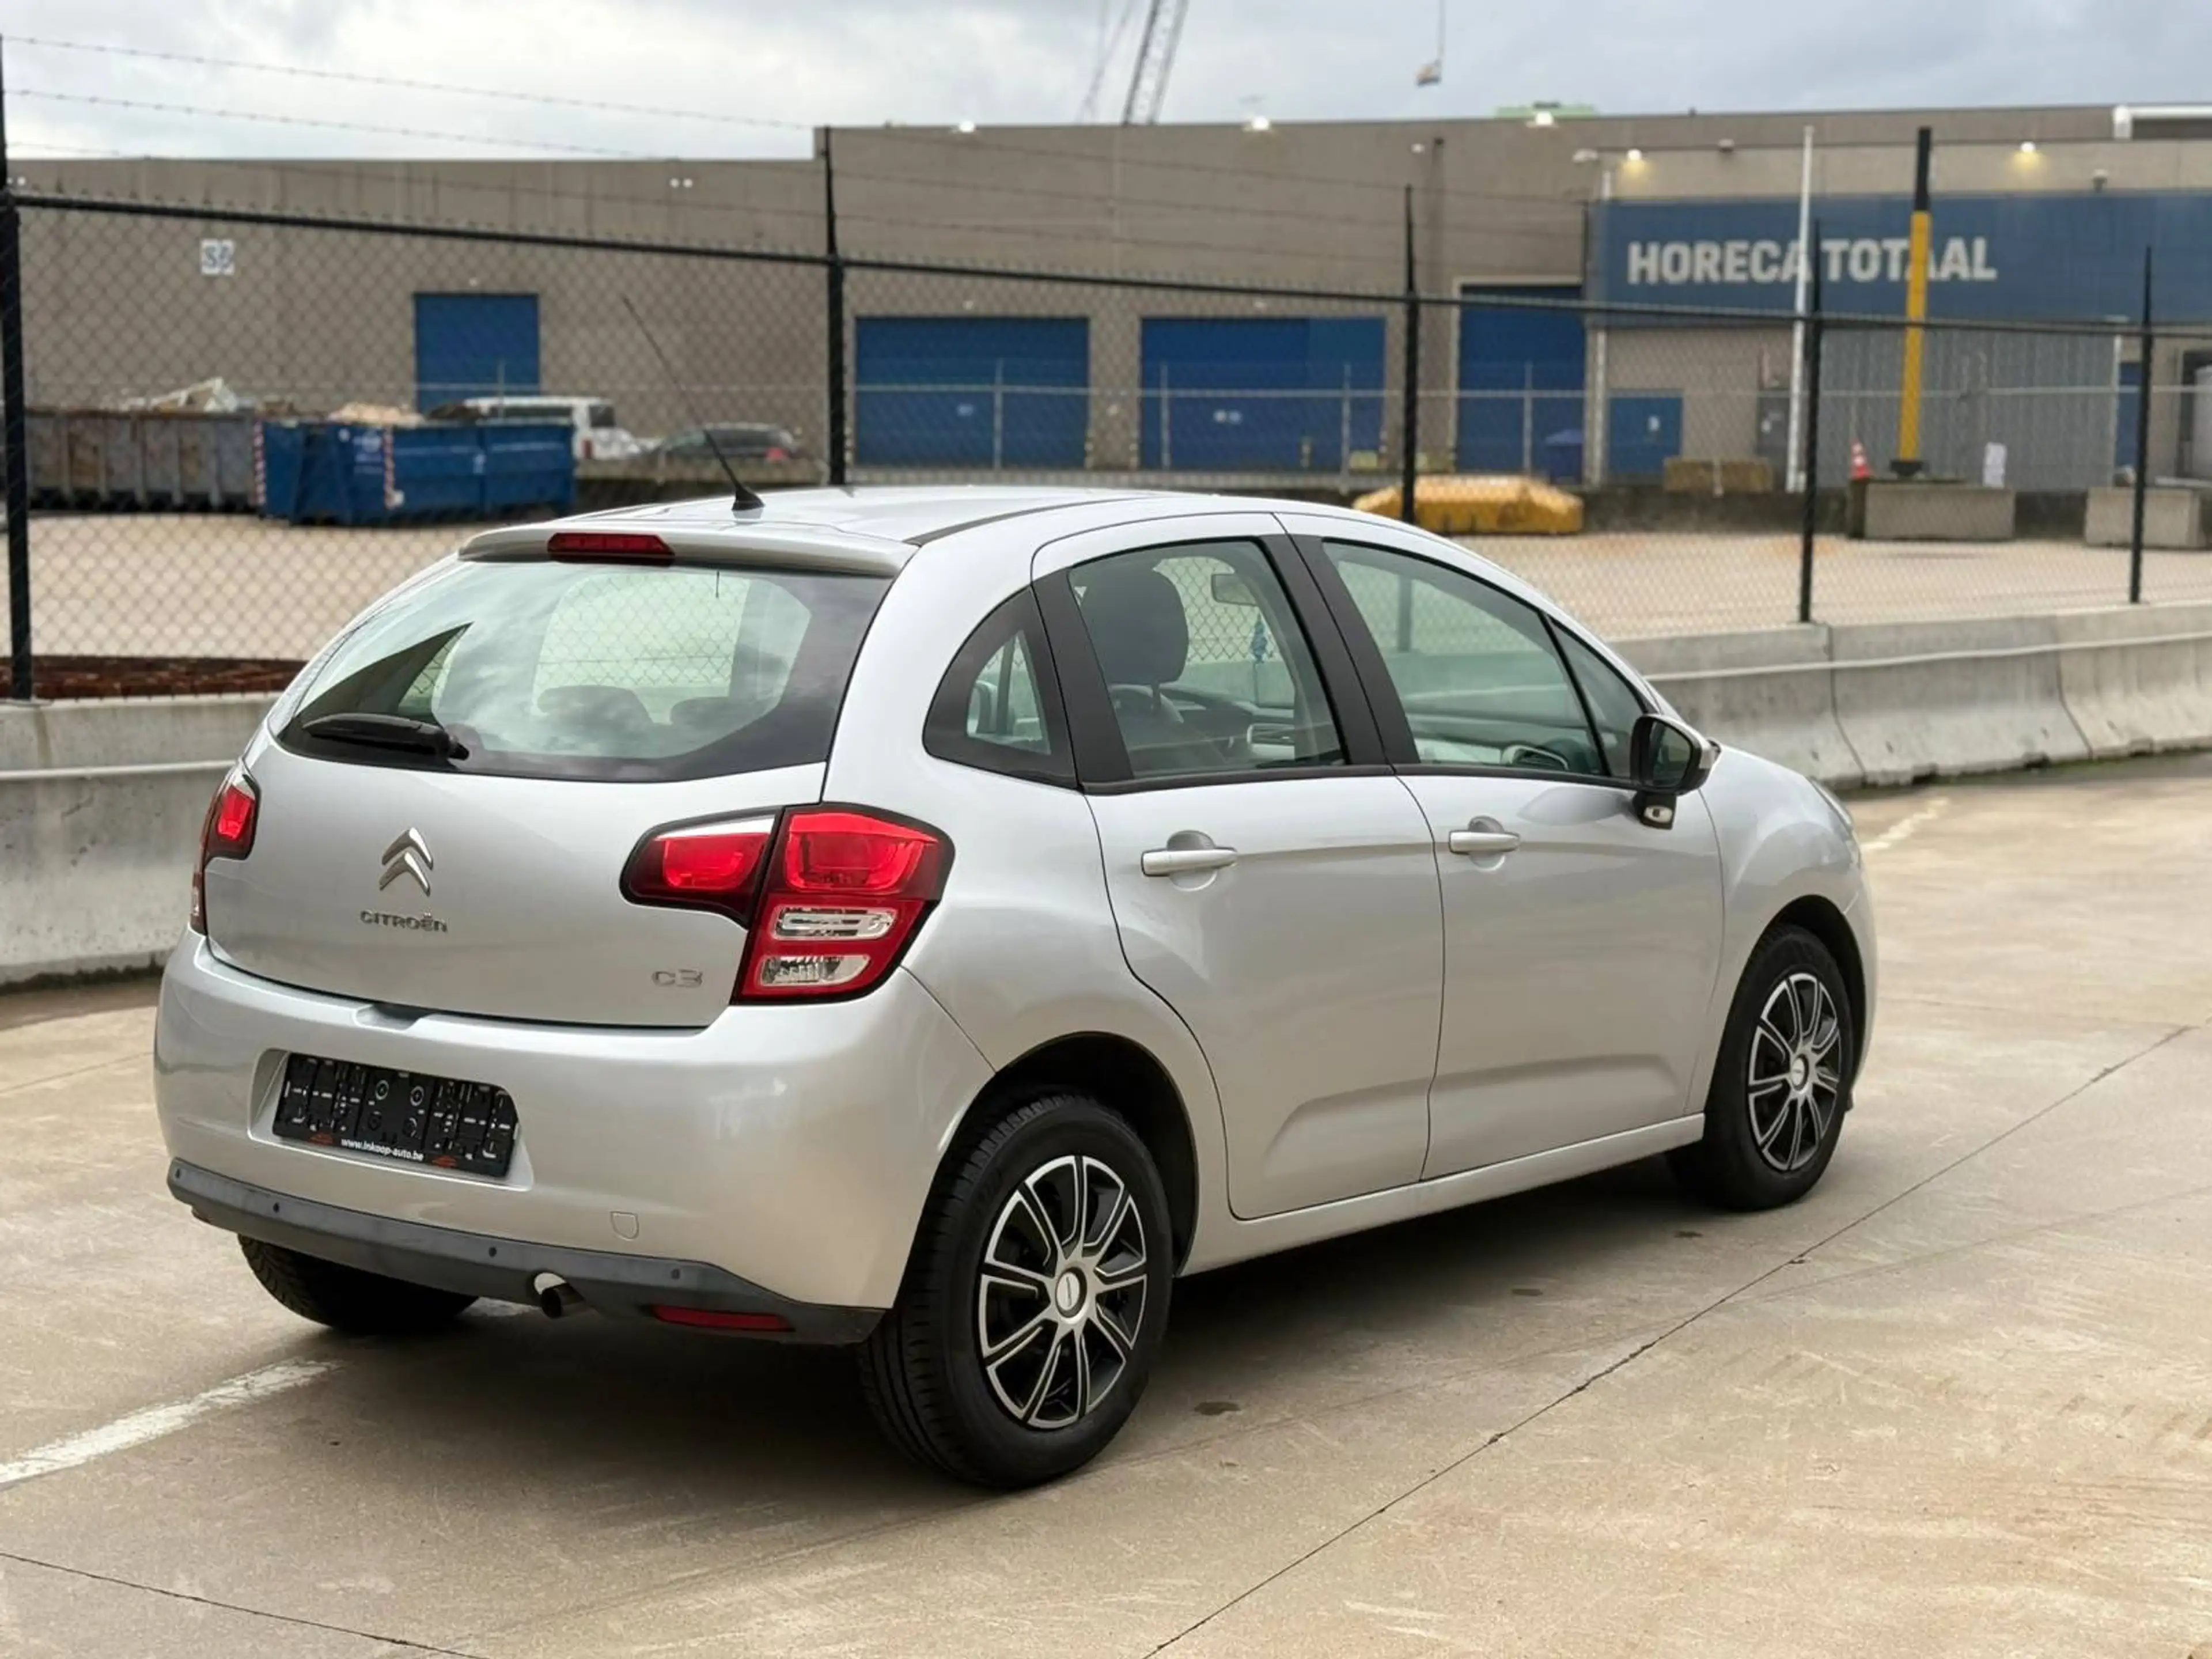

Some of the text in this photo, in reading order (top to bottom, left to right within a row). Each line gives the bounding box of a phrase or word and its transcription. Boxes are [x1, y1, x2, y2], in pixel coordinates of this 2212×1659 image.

[1627, 240, 1813, 285] HORECA
[359, 909, 449, 933] CITROËN
[651, 969, 703, 988] C3
[340, 1138, 425, 1162] www.inkoop-auto.be
